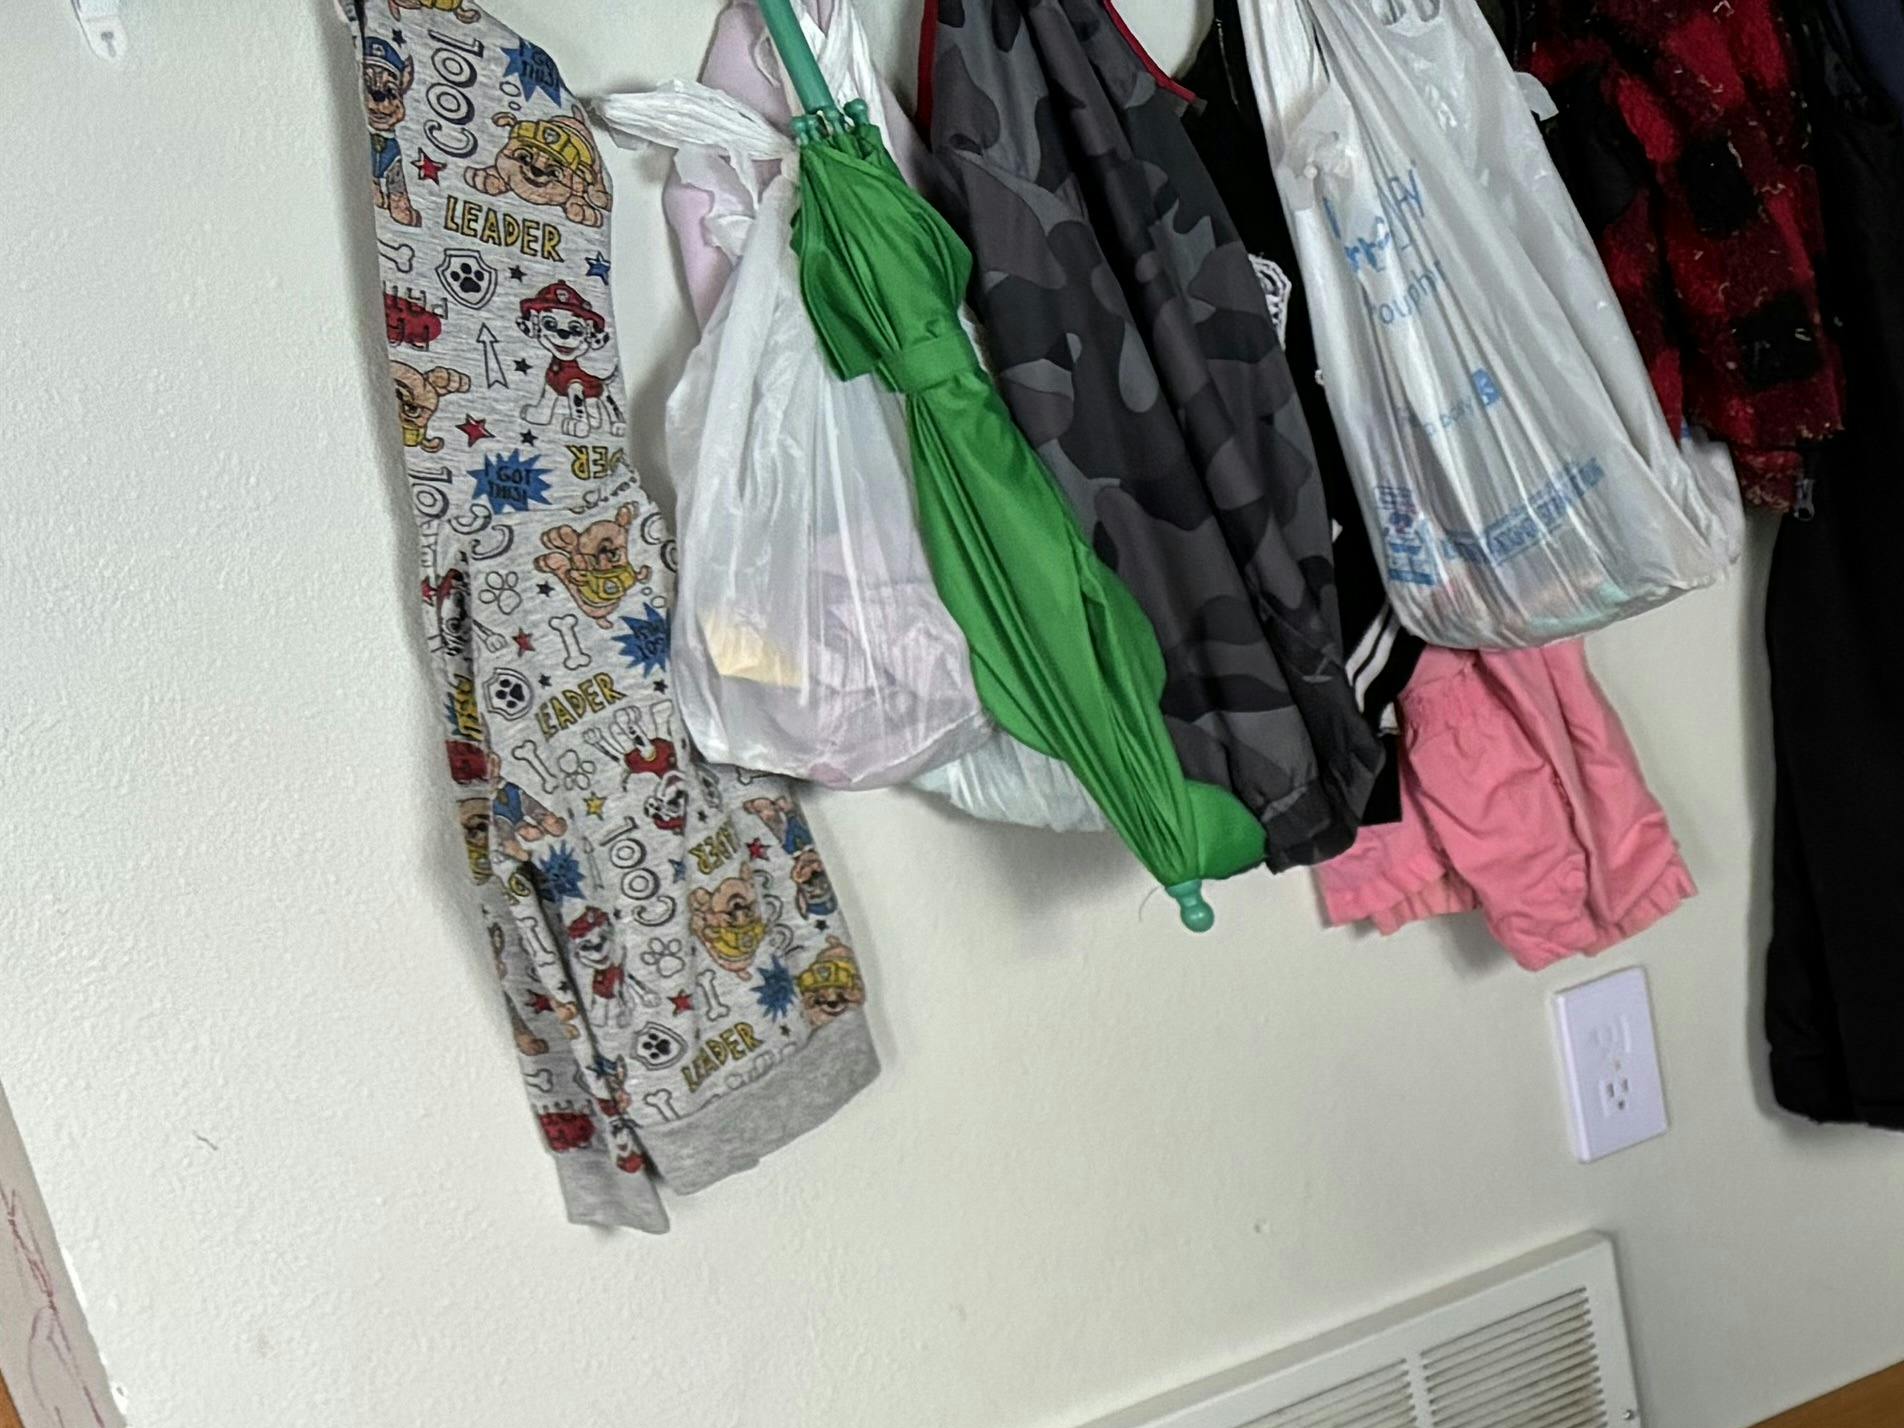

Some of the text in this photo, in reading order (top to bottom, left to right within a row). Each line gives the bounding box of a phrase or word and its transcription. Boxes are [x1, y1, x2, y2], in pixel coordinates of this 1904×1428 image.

[423, 29, 484, 158] COOL
[444, 195, 564, 262] LEADER
[497, 466, 532, 485] GOT
[535, 672, 628, 741] LEADER
[602, 816, 677, 927] COOL
[681, 1022, 764, 1093] LEADER
